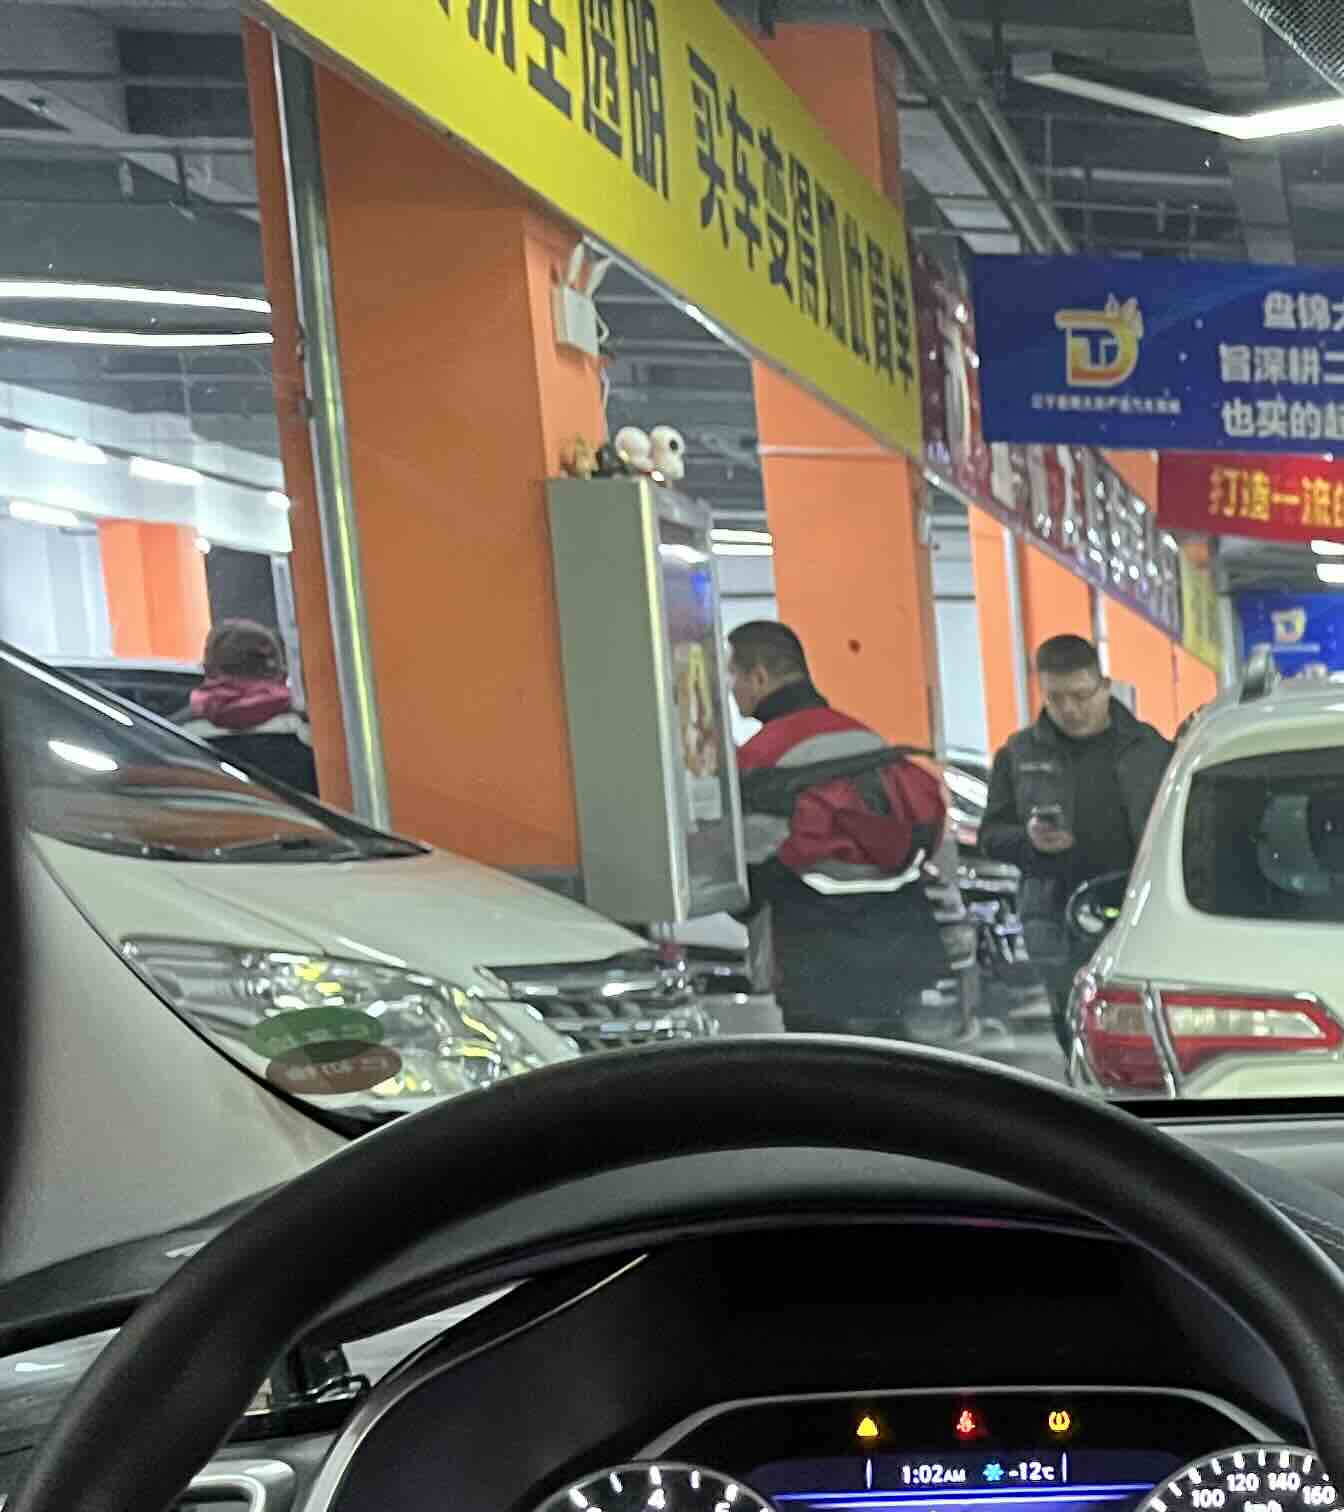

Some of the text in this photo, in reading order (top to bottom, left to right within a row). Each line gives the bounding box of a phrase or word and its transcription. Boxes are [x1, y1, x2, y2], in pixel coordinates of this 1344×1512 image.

[1226, 1472, 1259, 1492] 120
[1267, 1472, 1301, 1491] 140
[648, 1488, 666, 1509] 4
[1191, 1488, 1225, 1509] 100
[1302, 1486, 1336, 1505] 160
